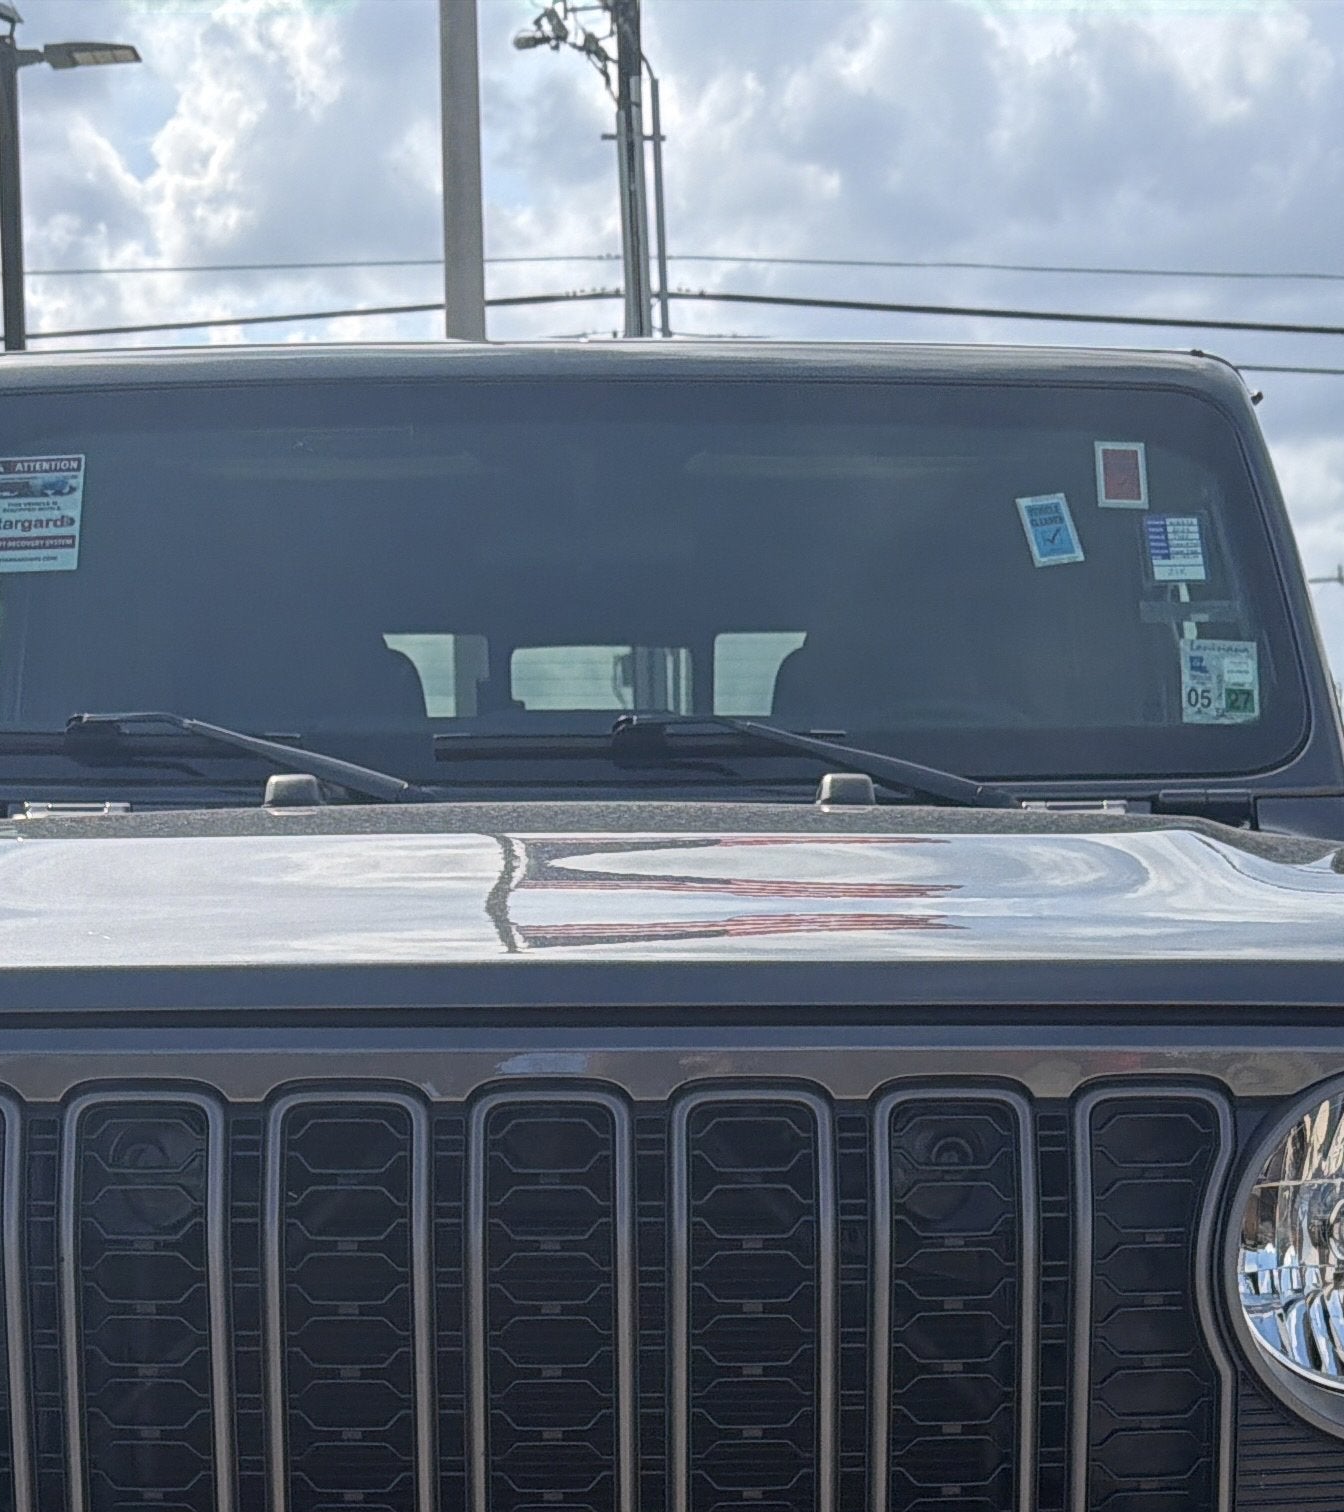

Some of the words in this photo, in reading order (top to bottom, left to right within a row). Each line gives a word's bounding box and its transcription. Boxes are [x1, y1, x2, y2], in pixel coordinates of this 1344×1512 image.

[15, 460, 79, 472] ATTENTION
[7, 539, 43, 548] RECOVERY
[44, 538, 73, 547] SYSTEM
[1187, 688, 1212, 709] 05
[1226, 690, 1251, 712] 27
